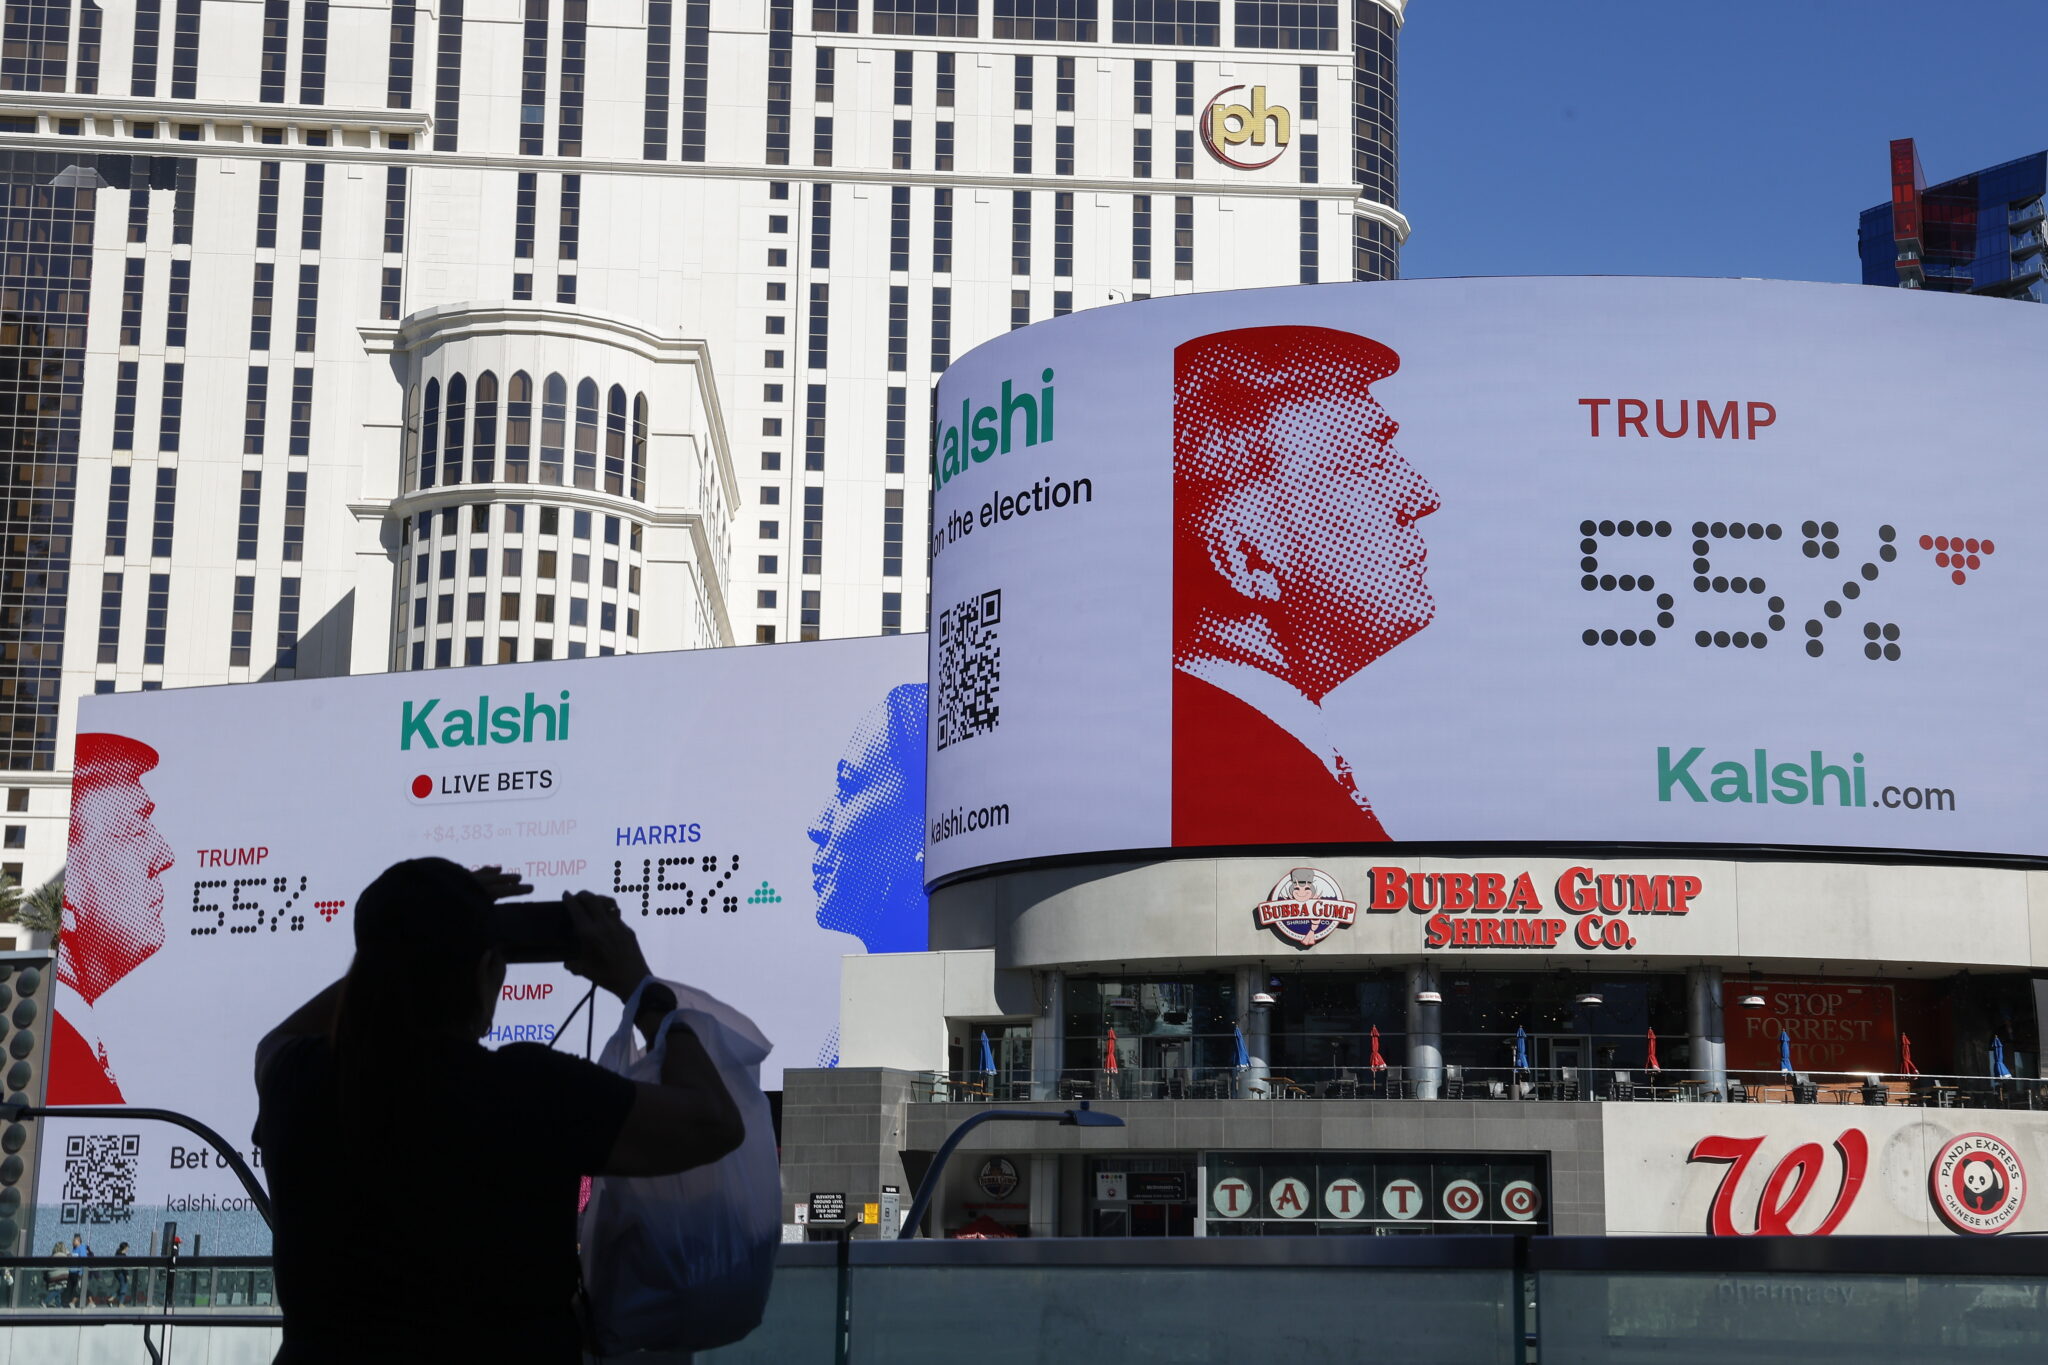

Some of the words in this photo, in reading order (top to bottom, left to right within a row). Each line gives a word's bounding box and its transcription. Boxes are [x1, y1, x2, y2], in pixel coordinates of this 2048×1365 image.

[1211, 85, 1291, 155] ph
[1578, 397, 1778, 441] TRUMP
[933, 527, 945, 558] on
[948, 509, 974, 544] the
[980, 476, 1093, 525] election
[1579, 518, 1902, 662] 55%
[400, 690, 571, 751] Kalshi
[441, 773, 490, 796] LIVE
[497, 769, 553, 792] BETS
[1656, 746, 1957, 812] Kalshi.com
[423, 823, 494, 844] +$4,383
[497, 827, 512, 838] on
[516, 819, 577, 838] TRUMP
[616, 823, 702, 848] HARRIS
[930, 803, 1010, 847] kalshi.com
[196, 846, 269, 869] TRUMP
[525, 859, 588, 878] TRUMP
[613, 854, 741, 917] 45%
[1370, 866, 1542, 912] BUBBA
[1558, 866, 1703, 914] GUMP
[190, 875, 308, 937] 55%
[1261, 902, 1310, 921] BUBBA
[1312, 900, 1355, 920] GUMP
[1427, 914, 1567, 947] SHRIMP
[501, 983, 554, 1001] RUMP
[1773, 992, 1844, 1017] STOP
[488, 1024, 556, 1042] HARRIS
[1745, 1017, 1873, 1042] FORREST
[1777, 1043, 1846, 1067] TOP
[170, 1146, 209, 1169] Bet
[1942, 1141, 1973, 1177] PANDA
[1975, 1139, 2020, 1180] EXPRESS
[1219, 1181, 1541, 1216] TATTOO
[1946, 1194, 1981, 1226] CHINESE
[1984, 1197, 2018, 1226] KITCHEN
